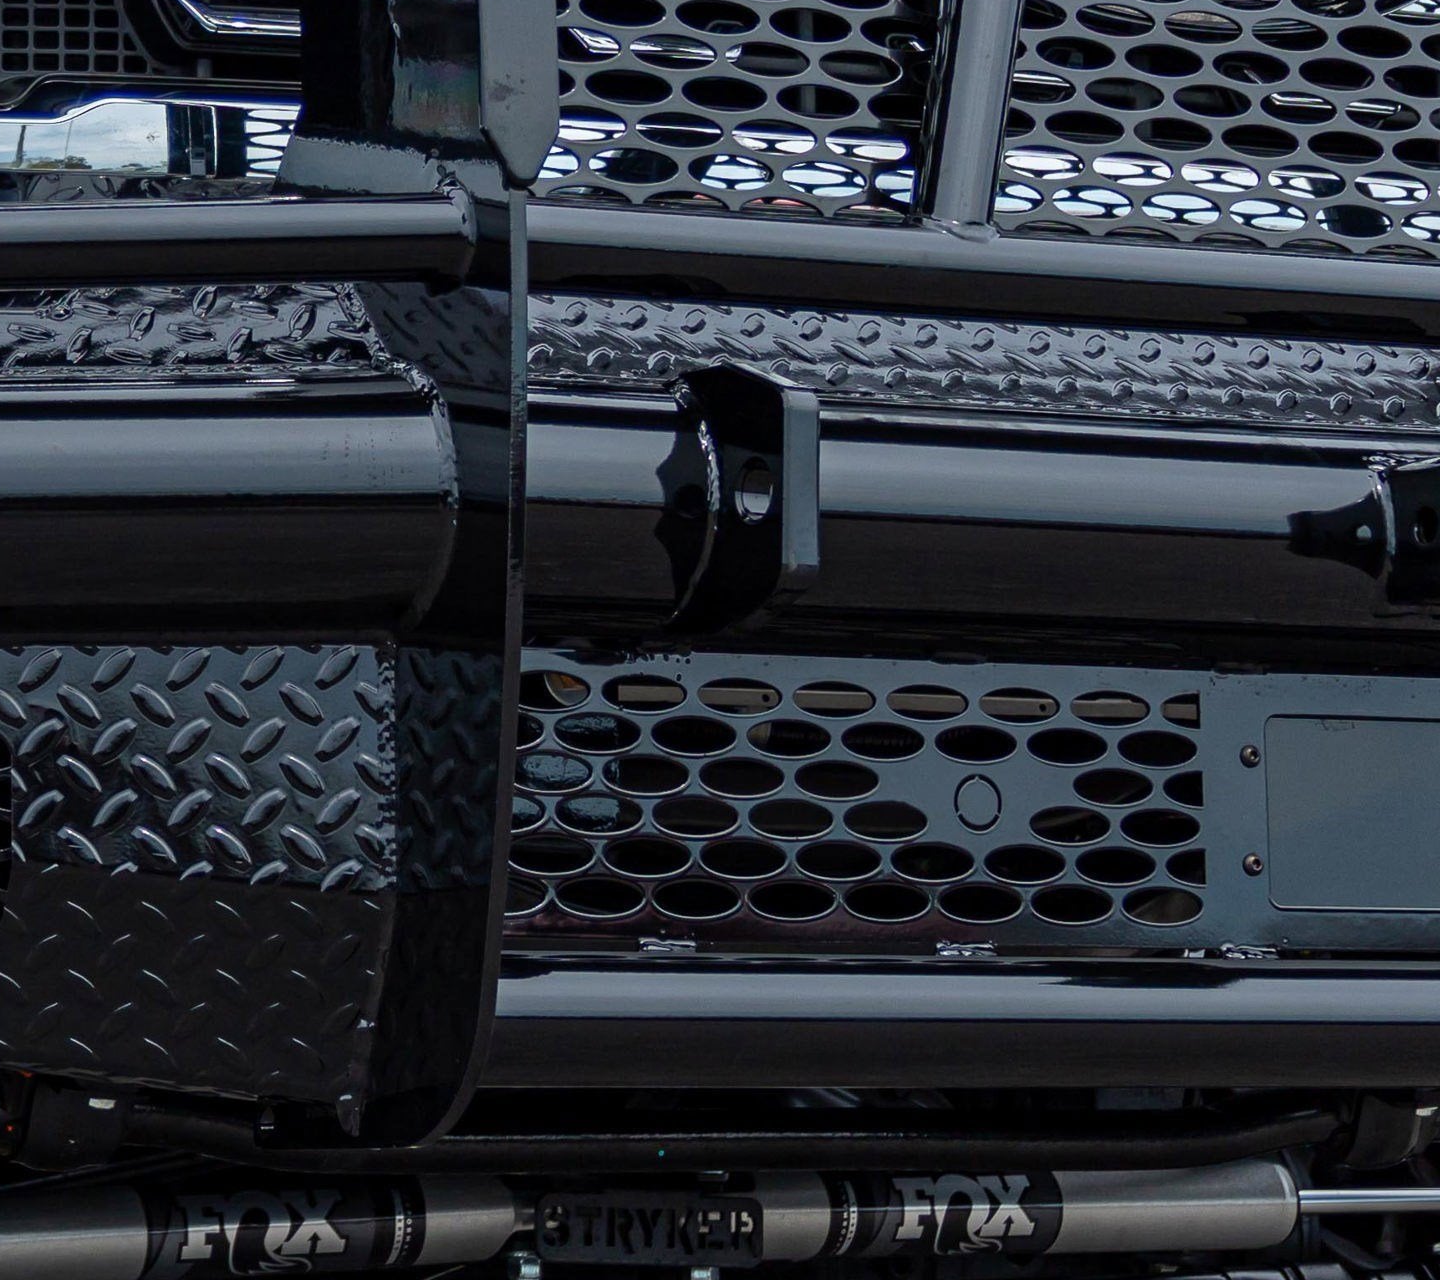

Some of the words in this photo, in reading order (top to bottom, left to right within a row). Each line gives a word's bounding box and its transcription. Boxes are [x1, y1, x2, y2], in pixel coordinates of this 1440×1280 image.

[175, 1189, 348, 1275] FOX
[541, 1204, 758, 1254] STRYKER
[891, 1174, 1035, 1255] FOX
